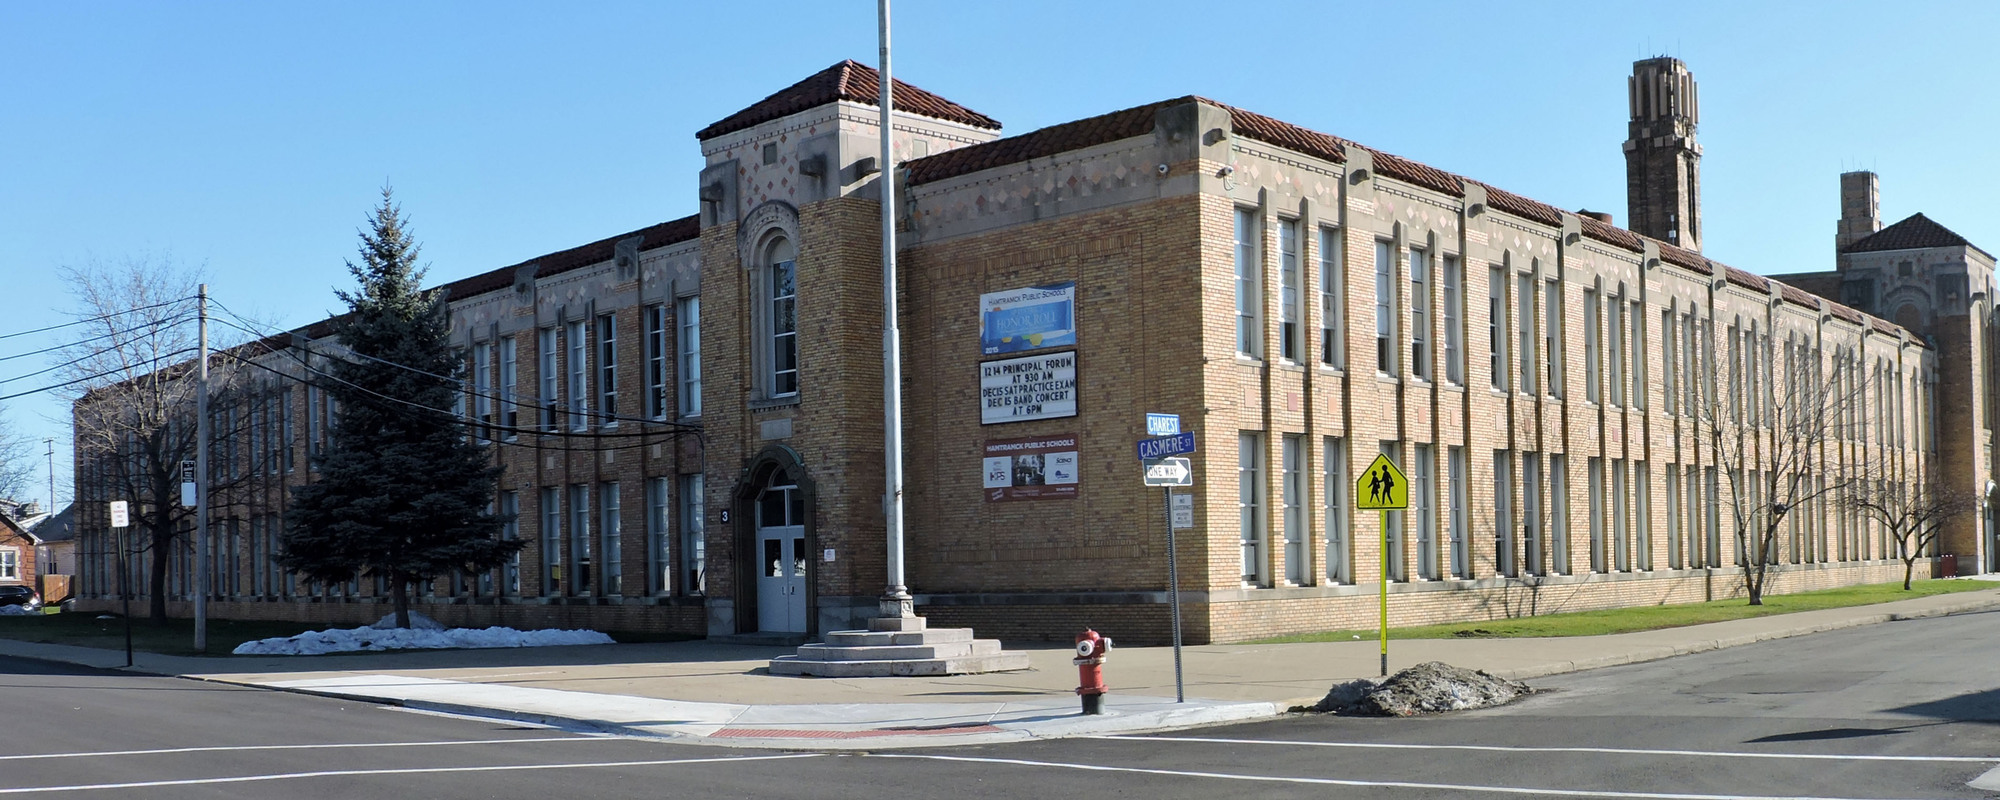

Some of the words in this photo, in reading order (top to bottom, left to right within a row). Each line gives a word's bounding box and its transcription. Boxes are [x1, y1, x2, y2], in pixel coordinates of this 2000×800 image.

[989, 296, 1021, 306] HAMTRAMCK
[1022, 293, 1041, 301] PUBLIC
[1043, 289, 1066, 298] SCHOOLS
[997, 316, 1030, 329] HONOR
[1034, 312, 1057, 323] ROLL
[1003, 362, 1042, 374] PRINCIPAL
[1046, 358, 1071, 369] FORUM
[1013, 375, 1021, 384] AT
[1025, 373, 1038, 382] 930
[1042, 371, 1053, 380] AM
[1005, 386, 1017, 395] SAT
[1019, 382, 1053, 393] PRACTICE
[1056, 379, 1075, 389] EXAM
[988, 398, 1002, 407] DEC
[1014, 394, 1032, 404] BAND
[1036, 391, 1068, 402] CONCERT
[1013, 407, 1022, 415] AT
[1027, 405, 1042, 414] 6PM
[1148, 416, 1178, 433] CHAREST
[987, 443, 1024, 452] HAMTRAMCK
[1047, 439, 1074, 448] SCHOOLS
[1140, 437, 1184, 457] CASMERE
[1149, 466, 1162, 476] ONE
[1165, 466, 1178, 476] WAY
[722, 511, 728, 521] 3
